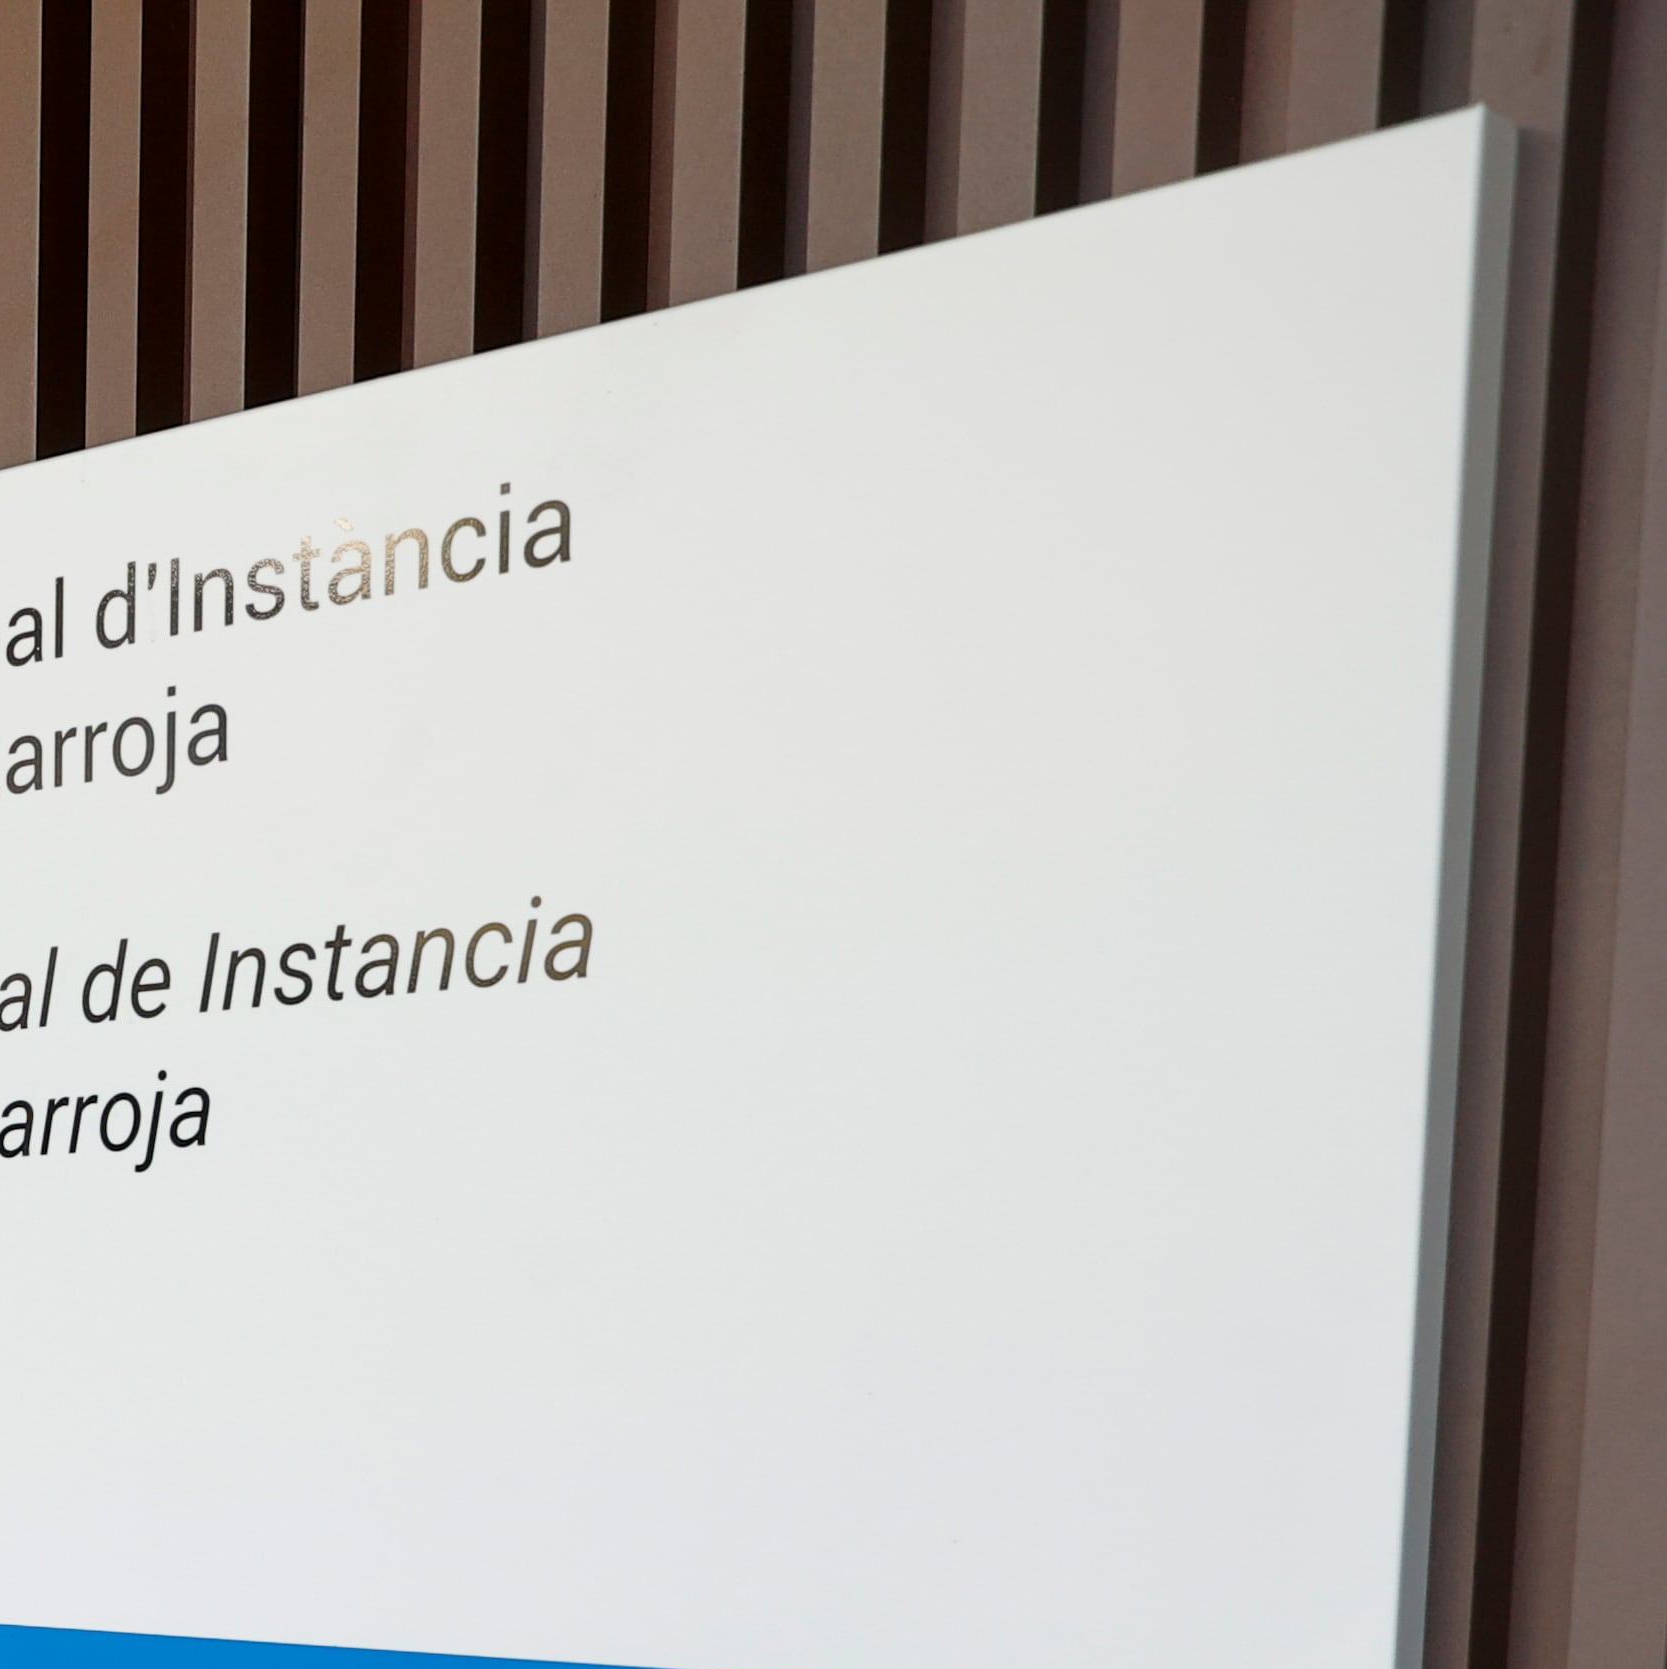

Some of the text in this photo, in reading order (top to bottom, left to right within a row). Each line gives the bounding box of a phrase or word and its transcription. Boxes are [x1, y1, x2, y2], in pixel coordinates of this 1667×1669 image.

[95, 481, 572, 650] d'Instància
[81, 937, 172, 1025] de
[199, 895, 594, 1014] Instancia
